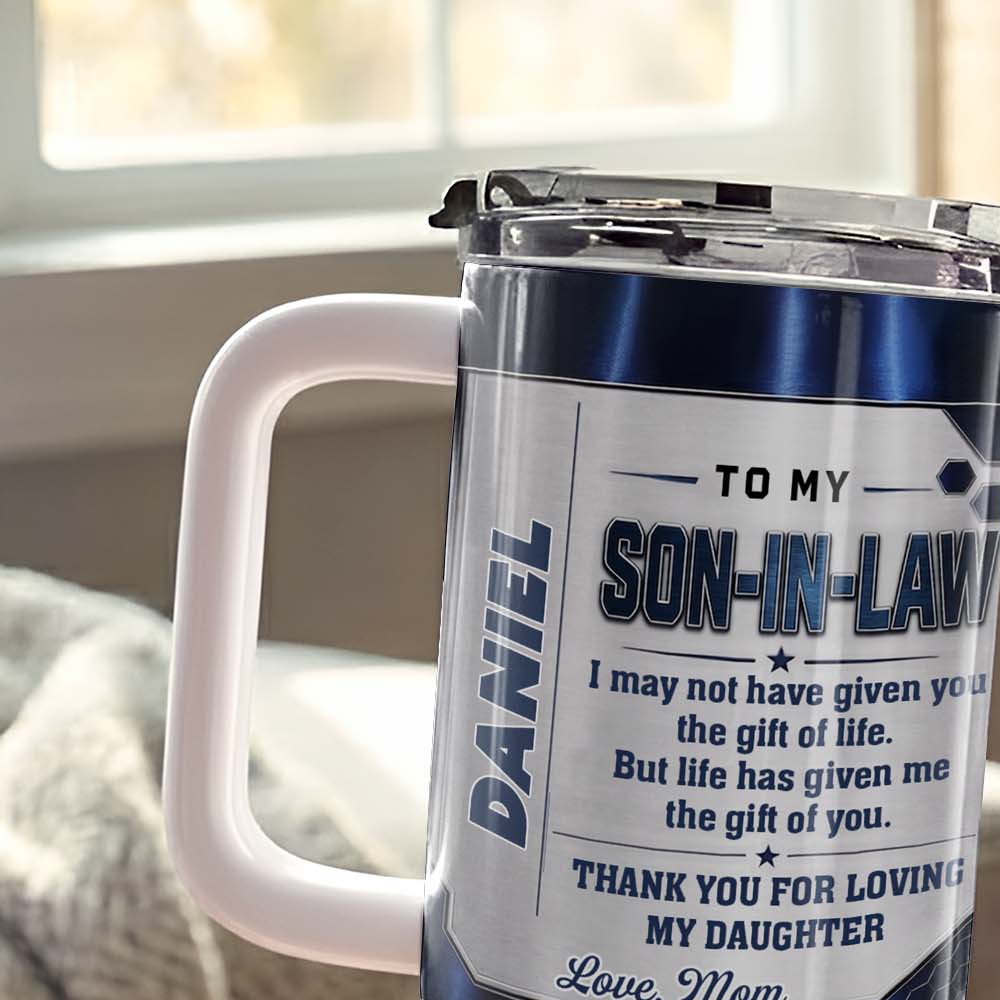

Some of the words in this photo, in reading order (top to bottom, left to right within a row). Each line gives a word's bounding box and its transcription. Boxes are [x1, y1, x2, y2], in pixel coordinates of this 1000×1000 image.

[715, 464, 771, 500] TO
[790, 468, 849, 503] MY
[600, 516, 1000, 634] SON-IN-LAW
[468, 519, 553, 849] DANIEL
[589, 659, 600, 688] I
[611, 666, 679, 707] may
[687, 678, 738, 703] not
[747, 675, 823, 705] have
[833, 672, 921, 712] given
[930, 671, 987, 705] you
[677, 714, 729, 748] the
[736, 715, 789, 753] gift
[798, 715, 831, 746] of
[836, 715, 893, 746] life.
[614, 750, 667, 786] But
[677, 756, 726, 790] life
[737, 758, 794, 791] has
[804, 758, 892, 798] given
[903, 758, 950, 784] me
[666, 799, 716, 833] the
[725, 802, 778, 840] gift
[788, 801, 819, 833] of
[827, 803, 891, 838] you.
[572, 858, 689, 901] THANK
[697, 874, 760, 907] YOU
[771, 874, 835, 906] FOR
[846, 857, 965, 899] LOVING
[646, 915, 698, 949] MY
[705, 912, 884, 952] DAUGHTER
